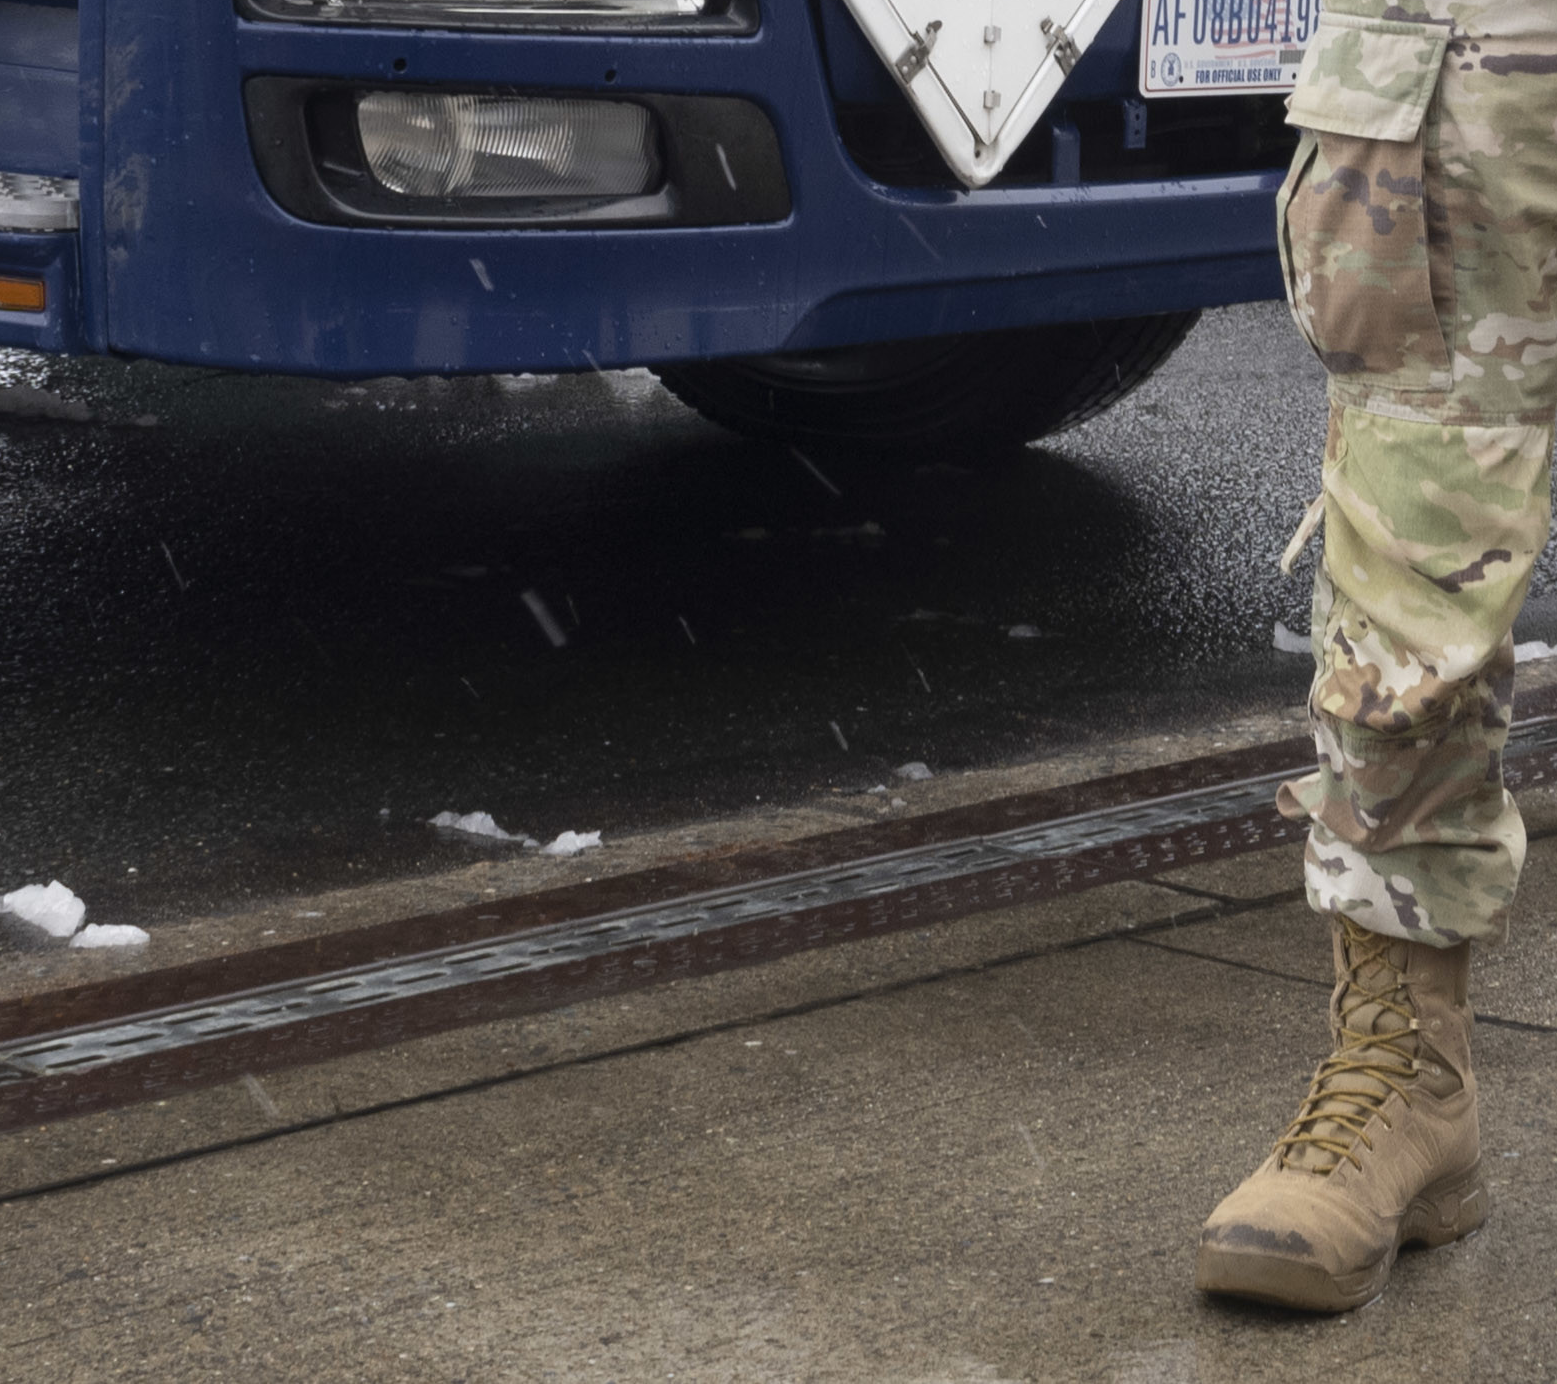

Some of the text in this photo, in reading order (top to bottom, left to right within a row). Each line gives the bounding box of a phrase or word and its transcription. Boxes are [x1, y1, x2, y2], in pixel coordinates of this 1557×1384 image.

[1195, 69, 1210, 84] FOR
[1212, 68, 1245, 83] OFFICIAL
[1247, 67, 1261, 82] USE
[1262, 67, 1282, 82] ONLY
